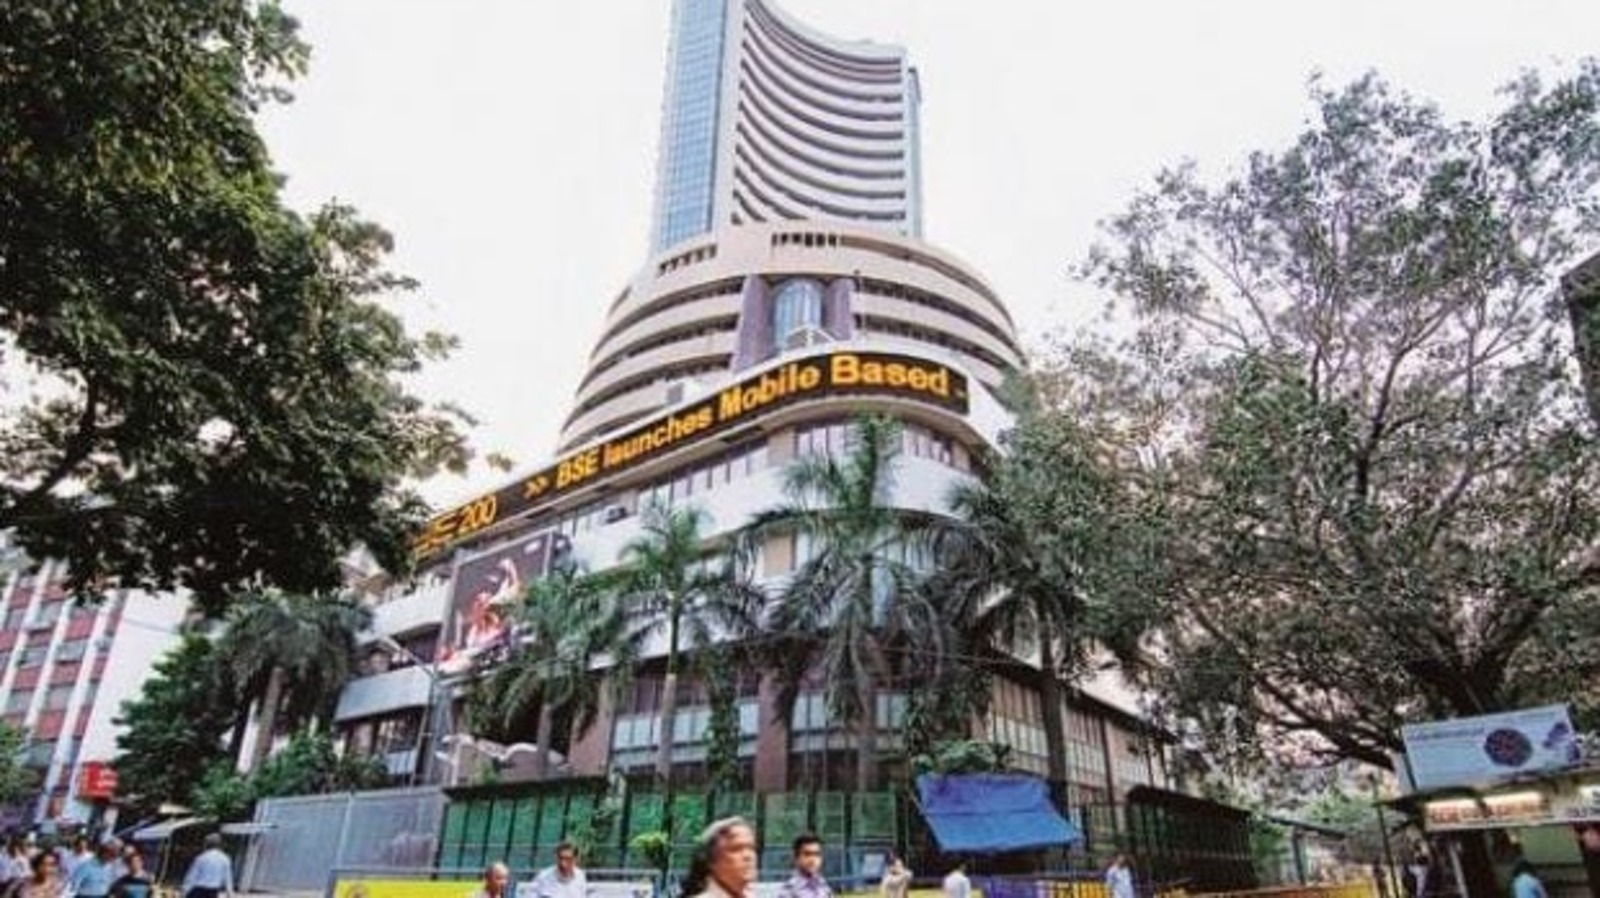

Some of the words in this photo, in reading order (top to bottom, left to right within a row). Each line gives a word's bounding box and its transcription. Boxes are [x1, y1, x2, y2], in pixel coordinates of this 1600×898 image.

[557, 449, 599, 489] BSE
[602, 407, 713, 468] launches
[718, 364, 821, 420] Mobile
[831, 354, 950, 396] Based
